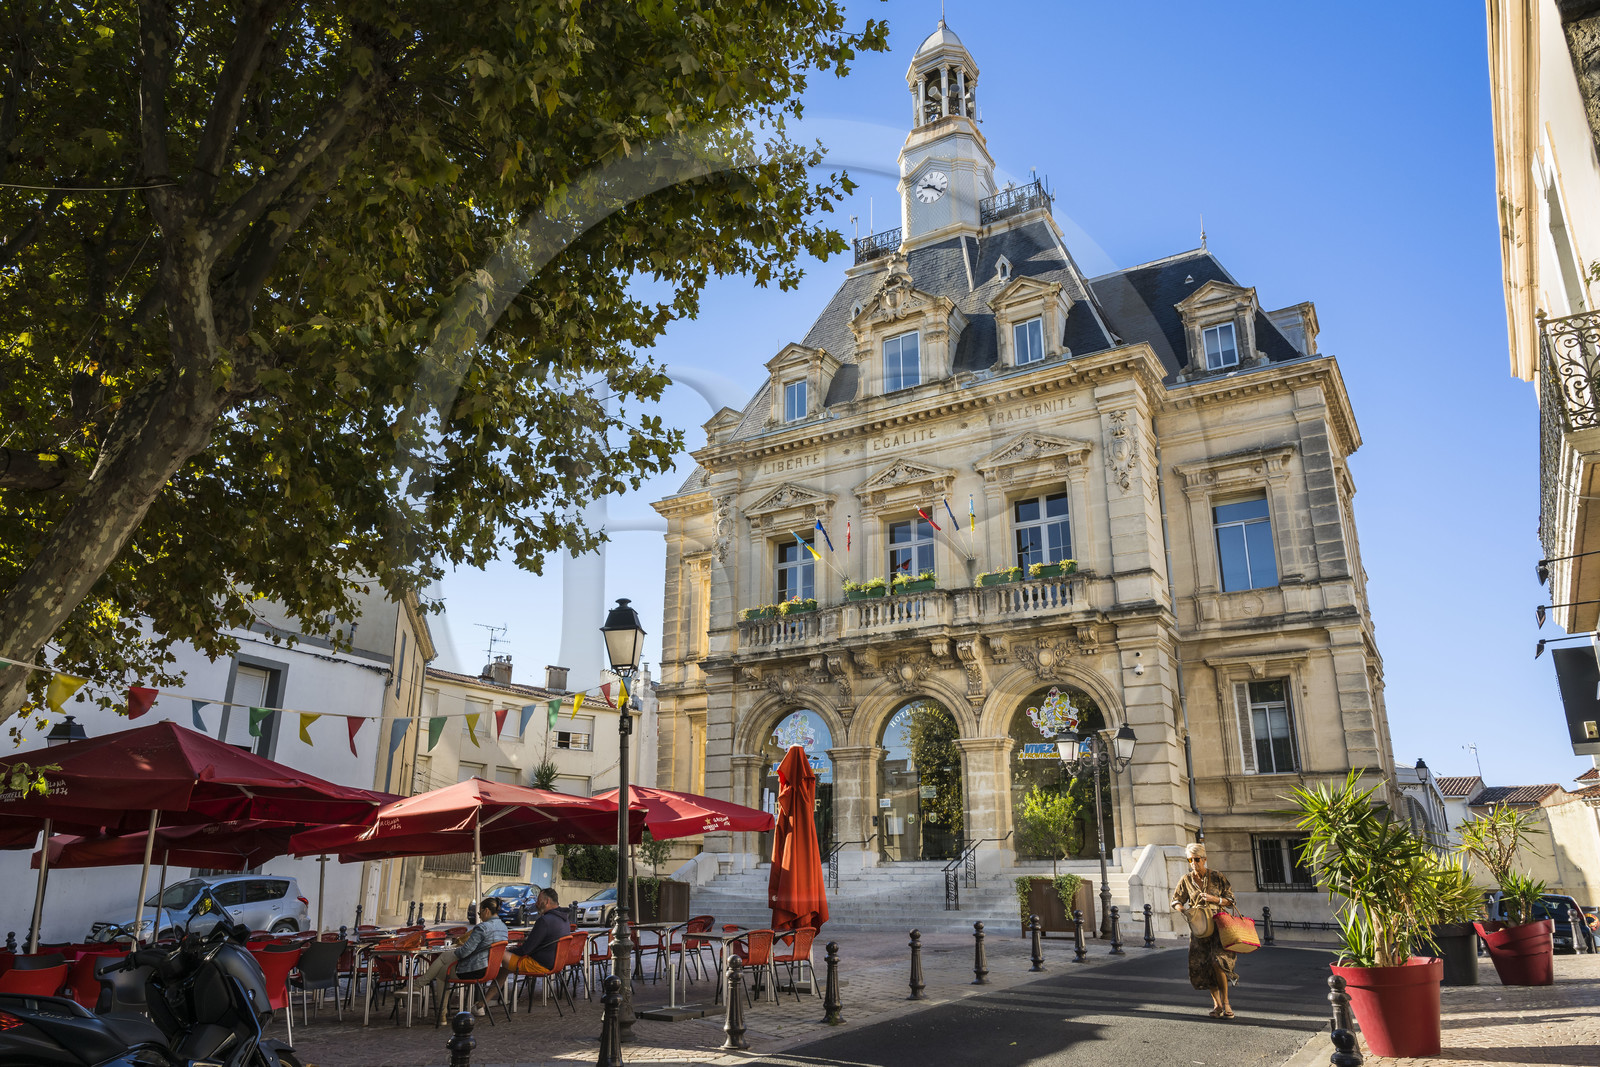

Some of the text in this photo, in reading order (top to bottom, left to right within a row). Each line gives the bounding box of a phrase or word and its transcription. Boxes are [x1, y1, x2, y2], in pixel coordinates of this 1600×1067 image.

[763, 452, 820, 475] LIBERTE
[987, 396, 1076, 425] FRATERNITE
[927, 706, 950, 724] VILLE
[1024, 743, 1055, 754] VIVEZ
